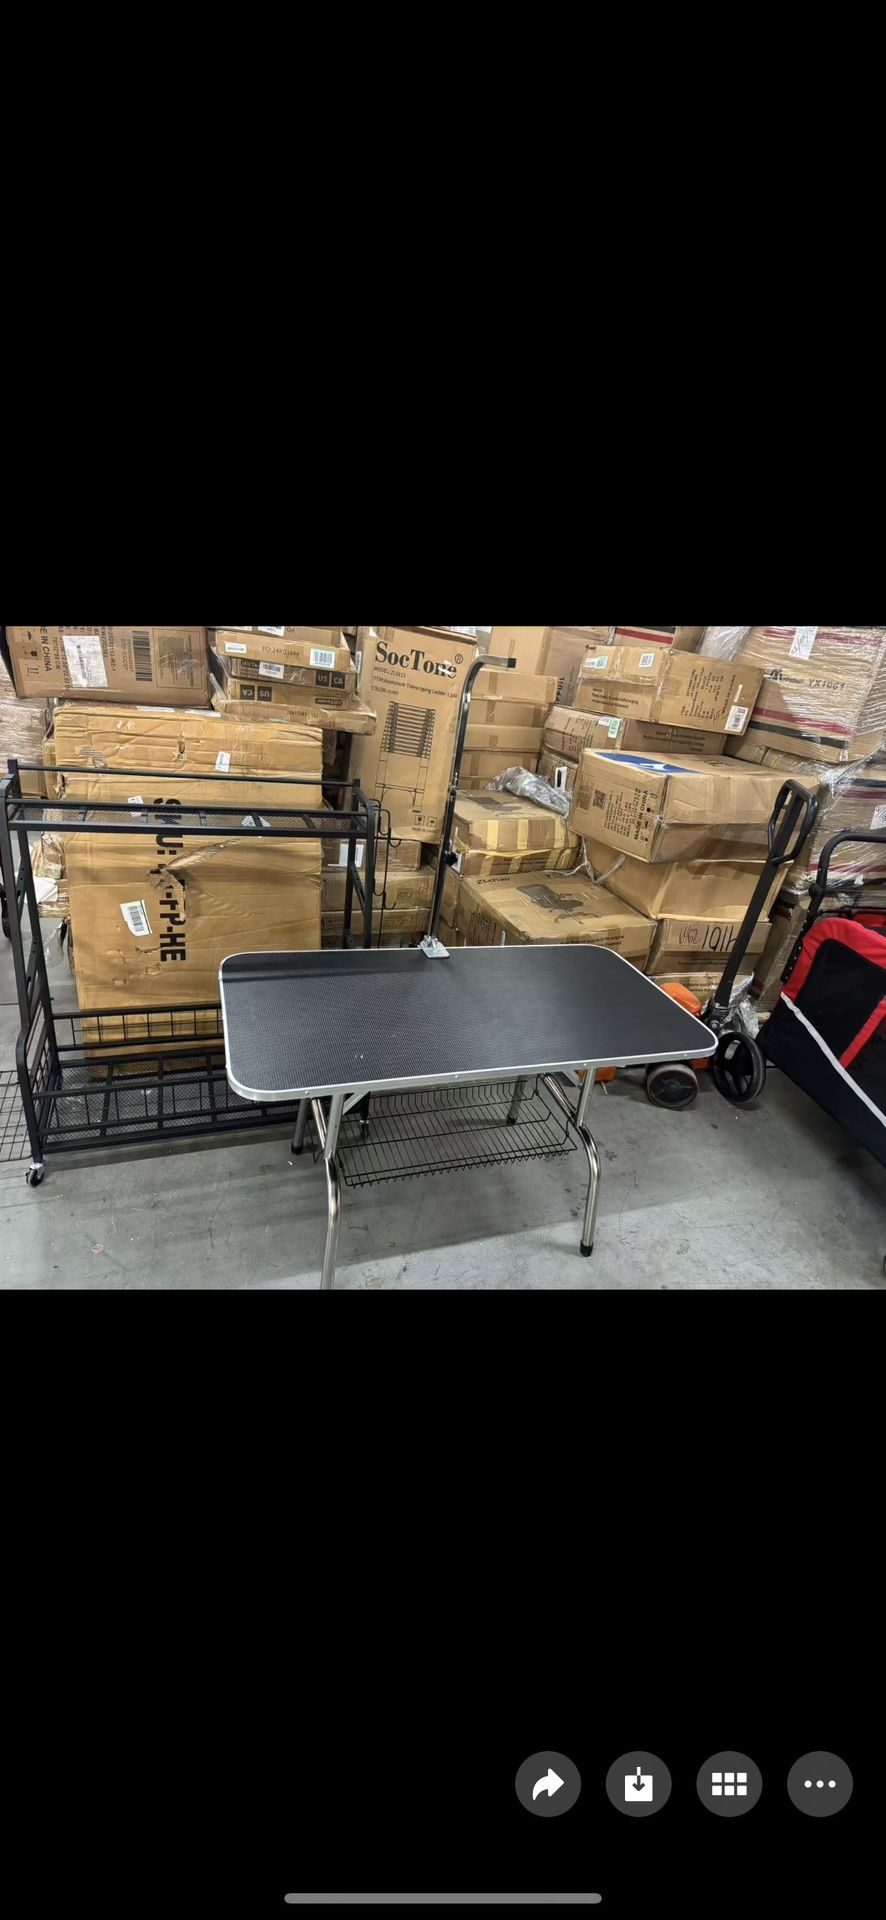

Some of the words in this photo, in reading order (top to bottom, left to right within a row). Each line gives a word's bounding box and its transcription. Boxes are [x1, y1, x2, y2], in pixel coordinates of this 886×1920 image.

[41, 635, 50, 645] IN
[42, 646, 52, 672] CHINA
[375, 641, 457, 678] SocTone
[317, 674, 328, 683] US
[728, 675, 736, 691] CHINA
[639, 790, 648, 811] CHINA
[638, 812, 644, 820] IN
[633, 821, 642, 840] MADE
